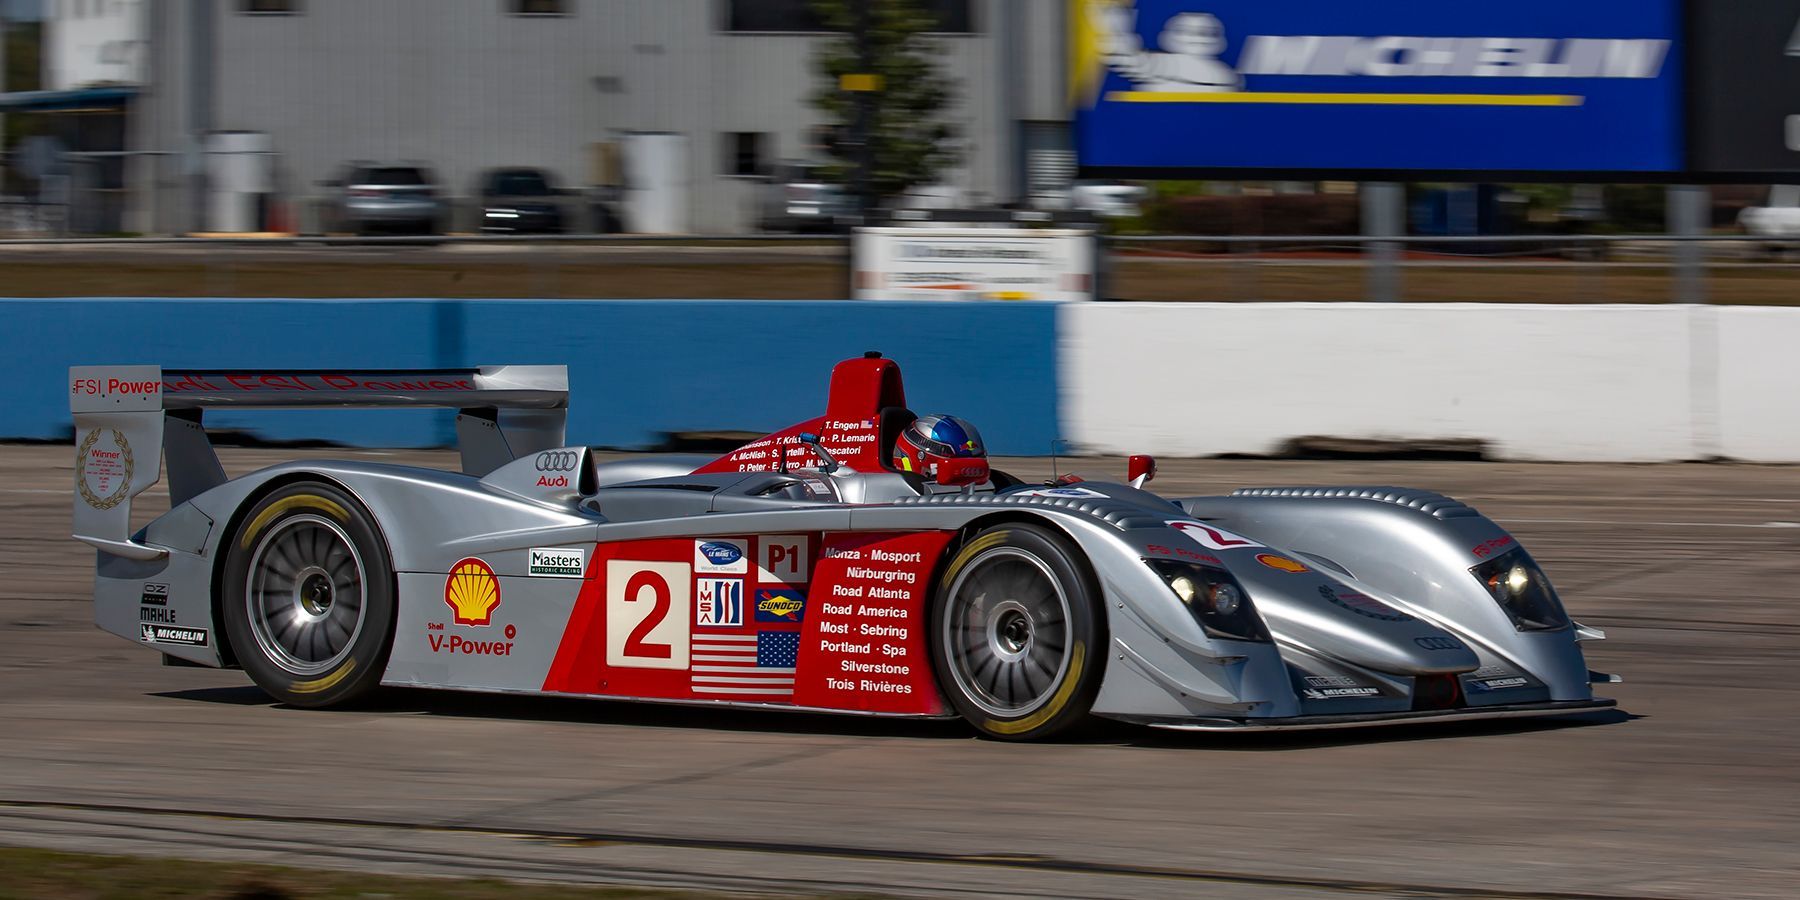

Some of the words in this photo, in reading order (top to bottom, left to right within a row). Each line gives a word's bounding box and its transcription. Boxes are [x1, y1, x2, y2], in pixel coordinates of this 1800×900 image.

[1236, 36, 1672, 78] MICHELIN
[75, 379, 101, 394] FSI
[108, 379, 160, 394] Power
[320, 375, 474, 390] Power
[825, 421, 831, 429] T.
[833, 421, 859, 431] Engen
[776, 437, 782, 445] T.
[832, 434, 840, 442] P.
[841, 433, 875, 443] Lemarie
[91, 449, 121, 459] Winner
[739, 450, 766, 460] McNish
[772, 449, 779, 458] S.
[786, 447, 805, 456] rtelli
[739, 464, 746, 472] P.
[747, 463, 766, 472] Peter
[772, 461, 779, 470] E.
[786, 461, 800, 469] irro
[806, 459, 815, 467] M.
[536, 475, 568, 487] Audi
[1169, 522, 1250, 546] 2
[532, 552, 580, 566] Masters
[769, 544, 798, 573] P1
[825, 547, 860, 559] Monza
[871, 549, 920, 564] Mosport
[846, 567, 915, 584] Nürburgring
[145, 584, 167, 593] OZ
[833, 585, 862, 597] Road
[868, 587, 910, 599] Atlanta
[700, 581, 712, 623] IMSA
[760, 601, 801, 610] SUNOCO
[141, 607, 176, 623] MAHLE
[623, 570, 671, 659] 2
[823, 603, 852, 615] Road
[857, 605, 907, 618] America
[427, 622, 444, 630] Shell
[820, 621, 849, 634] Most
[860, 623, 907, 640] Sebring
[157, 629, 204, 641] MICHELIN
[428, 634, 513, 656] V-Power
[821, 640, 870, 654] Portland
[882, 644, 906, 658] Spa
[841, 660, 909, 675] Silverstone
[826, 677, 855, 690] Trois
[860, 679, 912, 694] Rivières
[1322, 687, 1379, 695] MICHELIN
